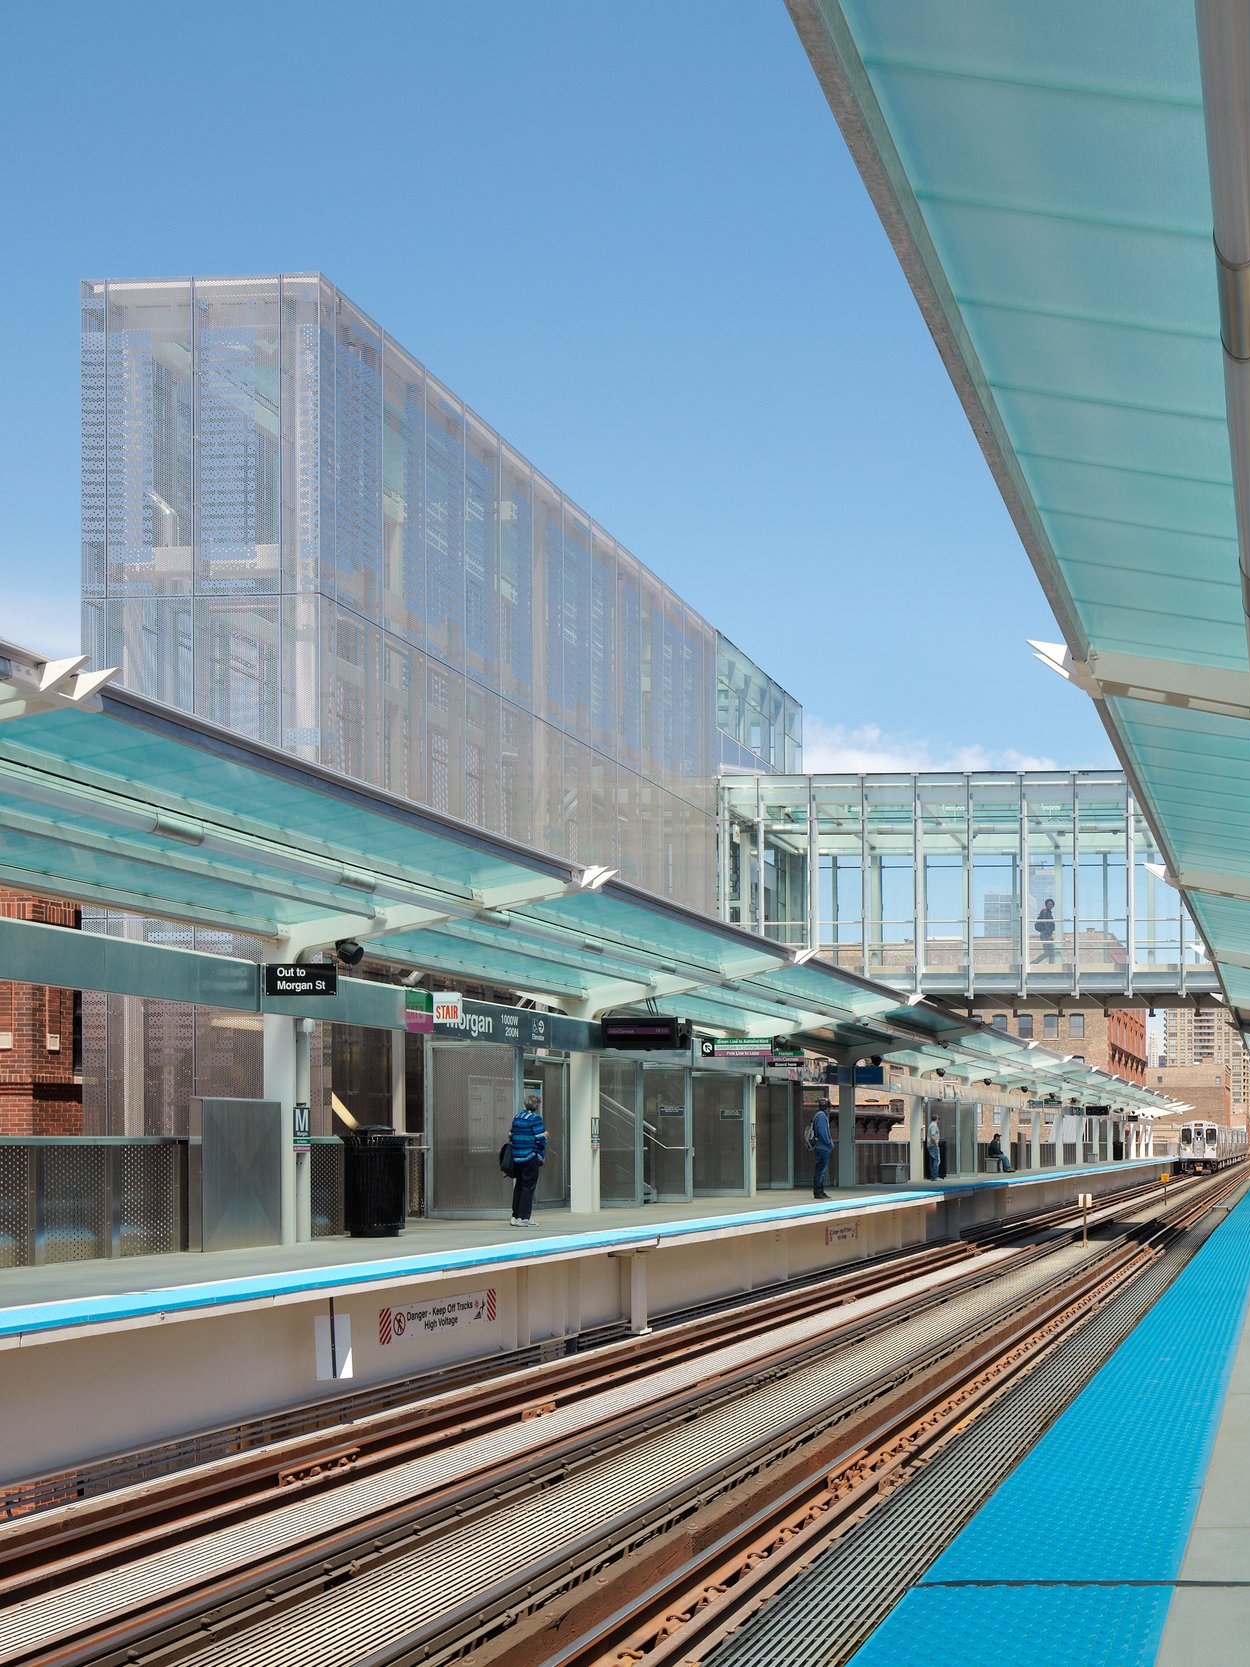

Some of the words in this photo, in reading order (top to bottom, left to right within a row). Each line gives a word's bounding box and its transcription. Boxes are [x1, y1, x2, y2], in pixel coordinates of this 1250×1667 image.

[277, 967, 294, 977] Out
[295, 968, 306, 977] to
[277, 980, 313, 992] Morgan
[315, 980, 326, 990] St
[436, 1005, 458, 1019] STAIR
[501, 1013, 519, 1026] 1000W
[505, 1027, 519, 1037] 200N
[295, 1108, 309, 1132] M
[406, 1309, 428, 1321] Danger
[432, 1306, 446, 1317] Keep
[447, 1303, 456, 1314] Off
[457, 1301, 473, 1311] Tracks
[424, 1320, 437, 1331] High
[438, 1316, 458, 1326] Voltage
